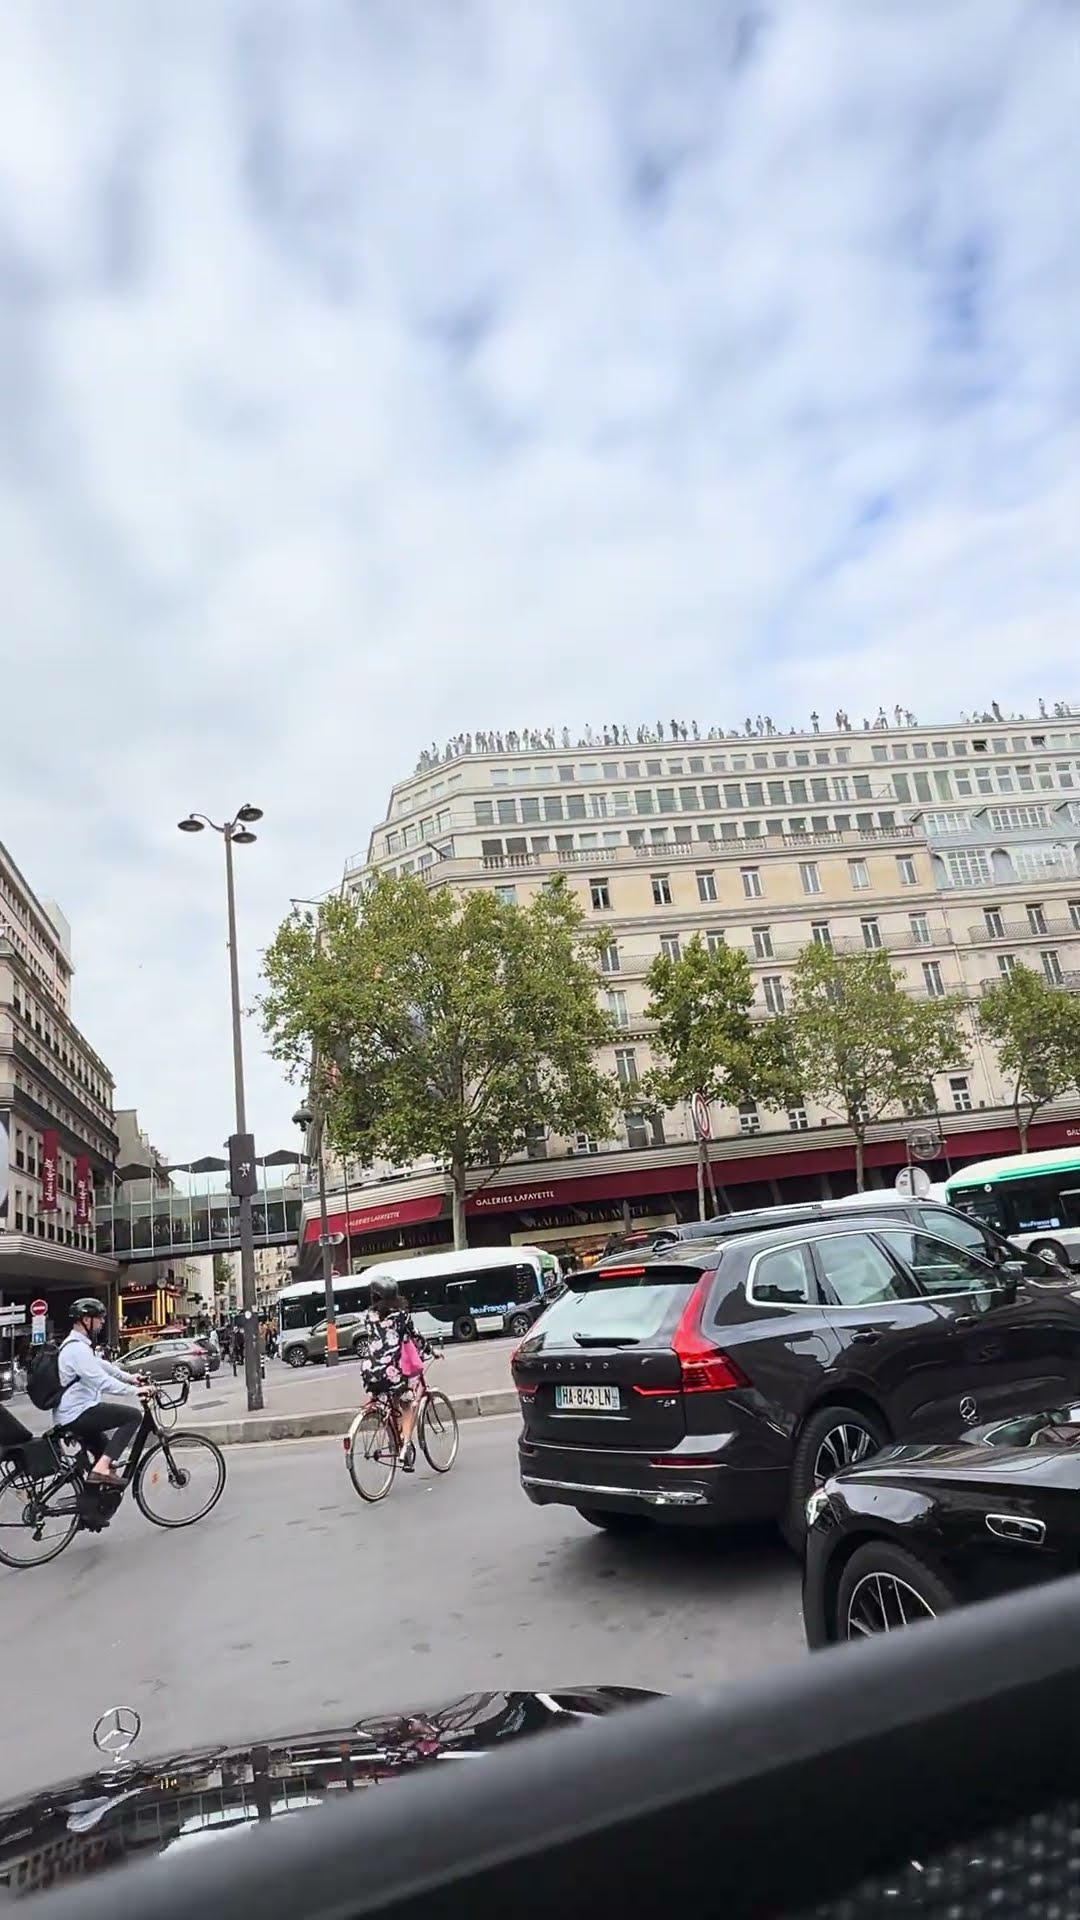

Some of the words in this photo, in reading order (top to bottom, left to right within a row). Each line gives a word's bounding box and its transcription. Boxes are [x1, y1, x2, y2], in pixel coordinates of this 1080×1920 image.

[475, 1196, 512, 1207] GALERIES
[514, 1190, 555, 1202] LAFAYETTE
[563, 1388, 611, 1406] HA-843-LN
